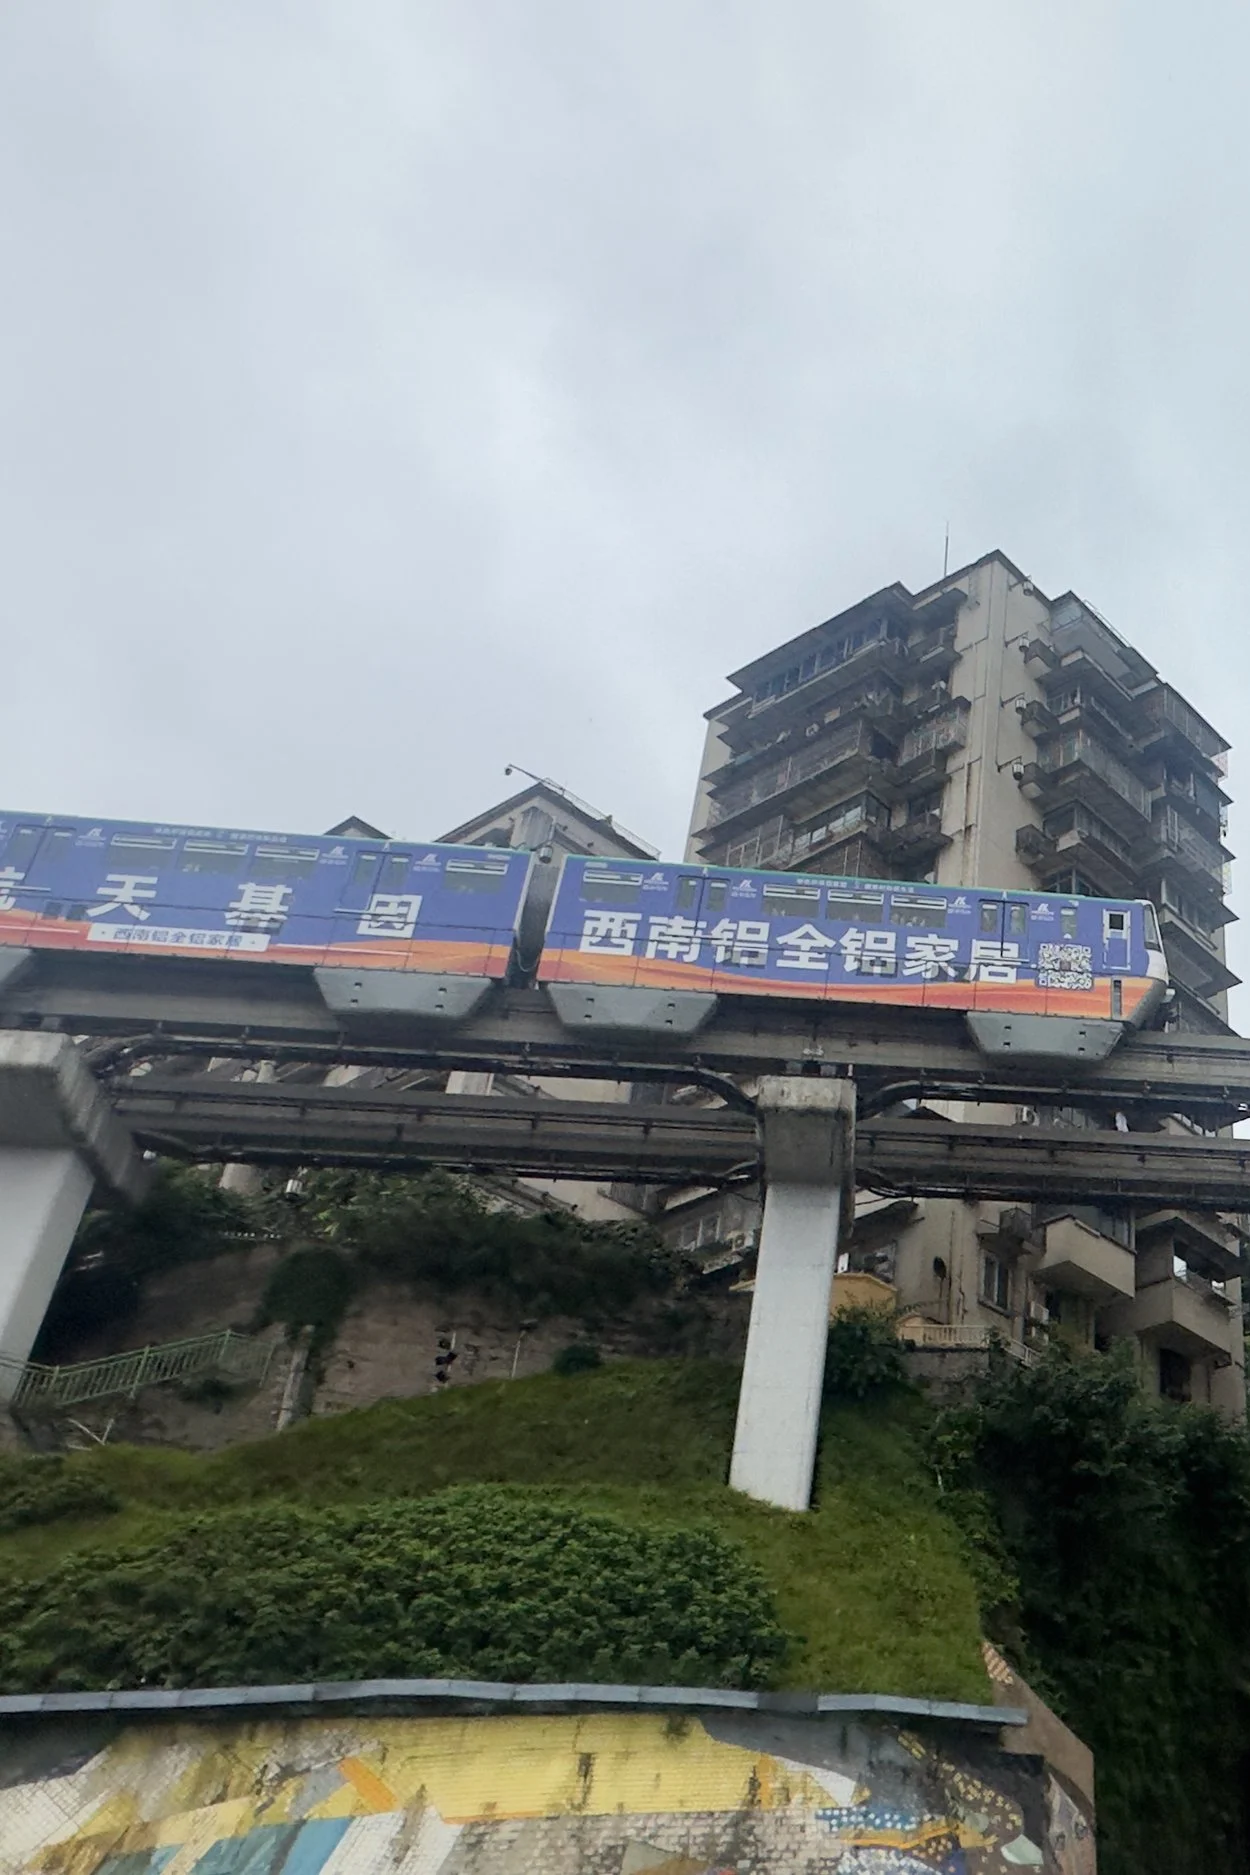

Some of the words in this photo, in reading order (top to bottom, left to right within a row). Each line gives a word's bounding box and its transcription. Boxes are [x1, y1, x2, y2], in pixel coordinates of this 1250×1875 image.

[579, 909, 1022, 984] 西南铝全铝家居
